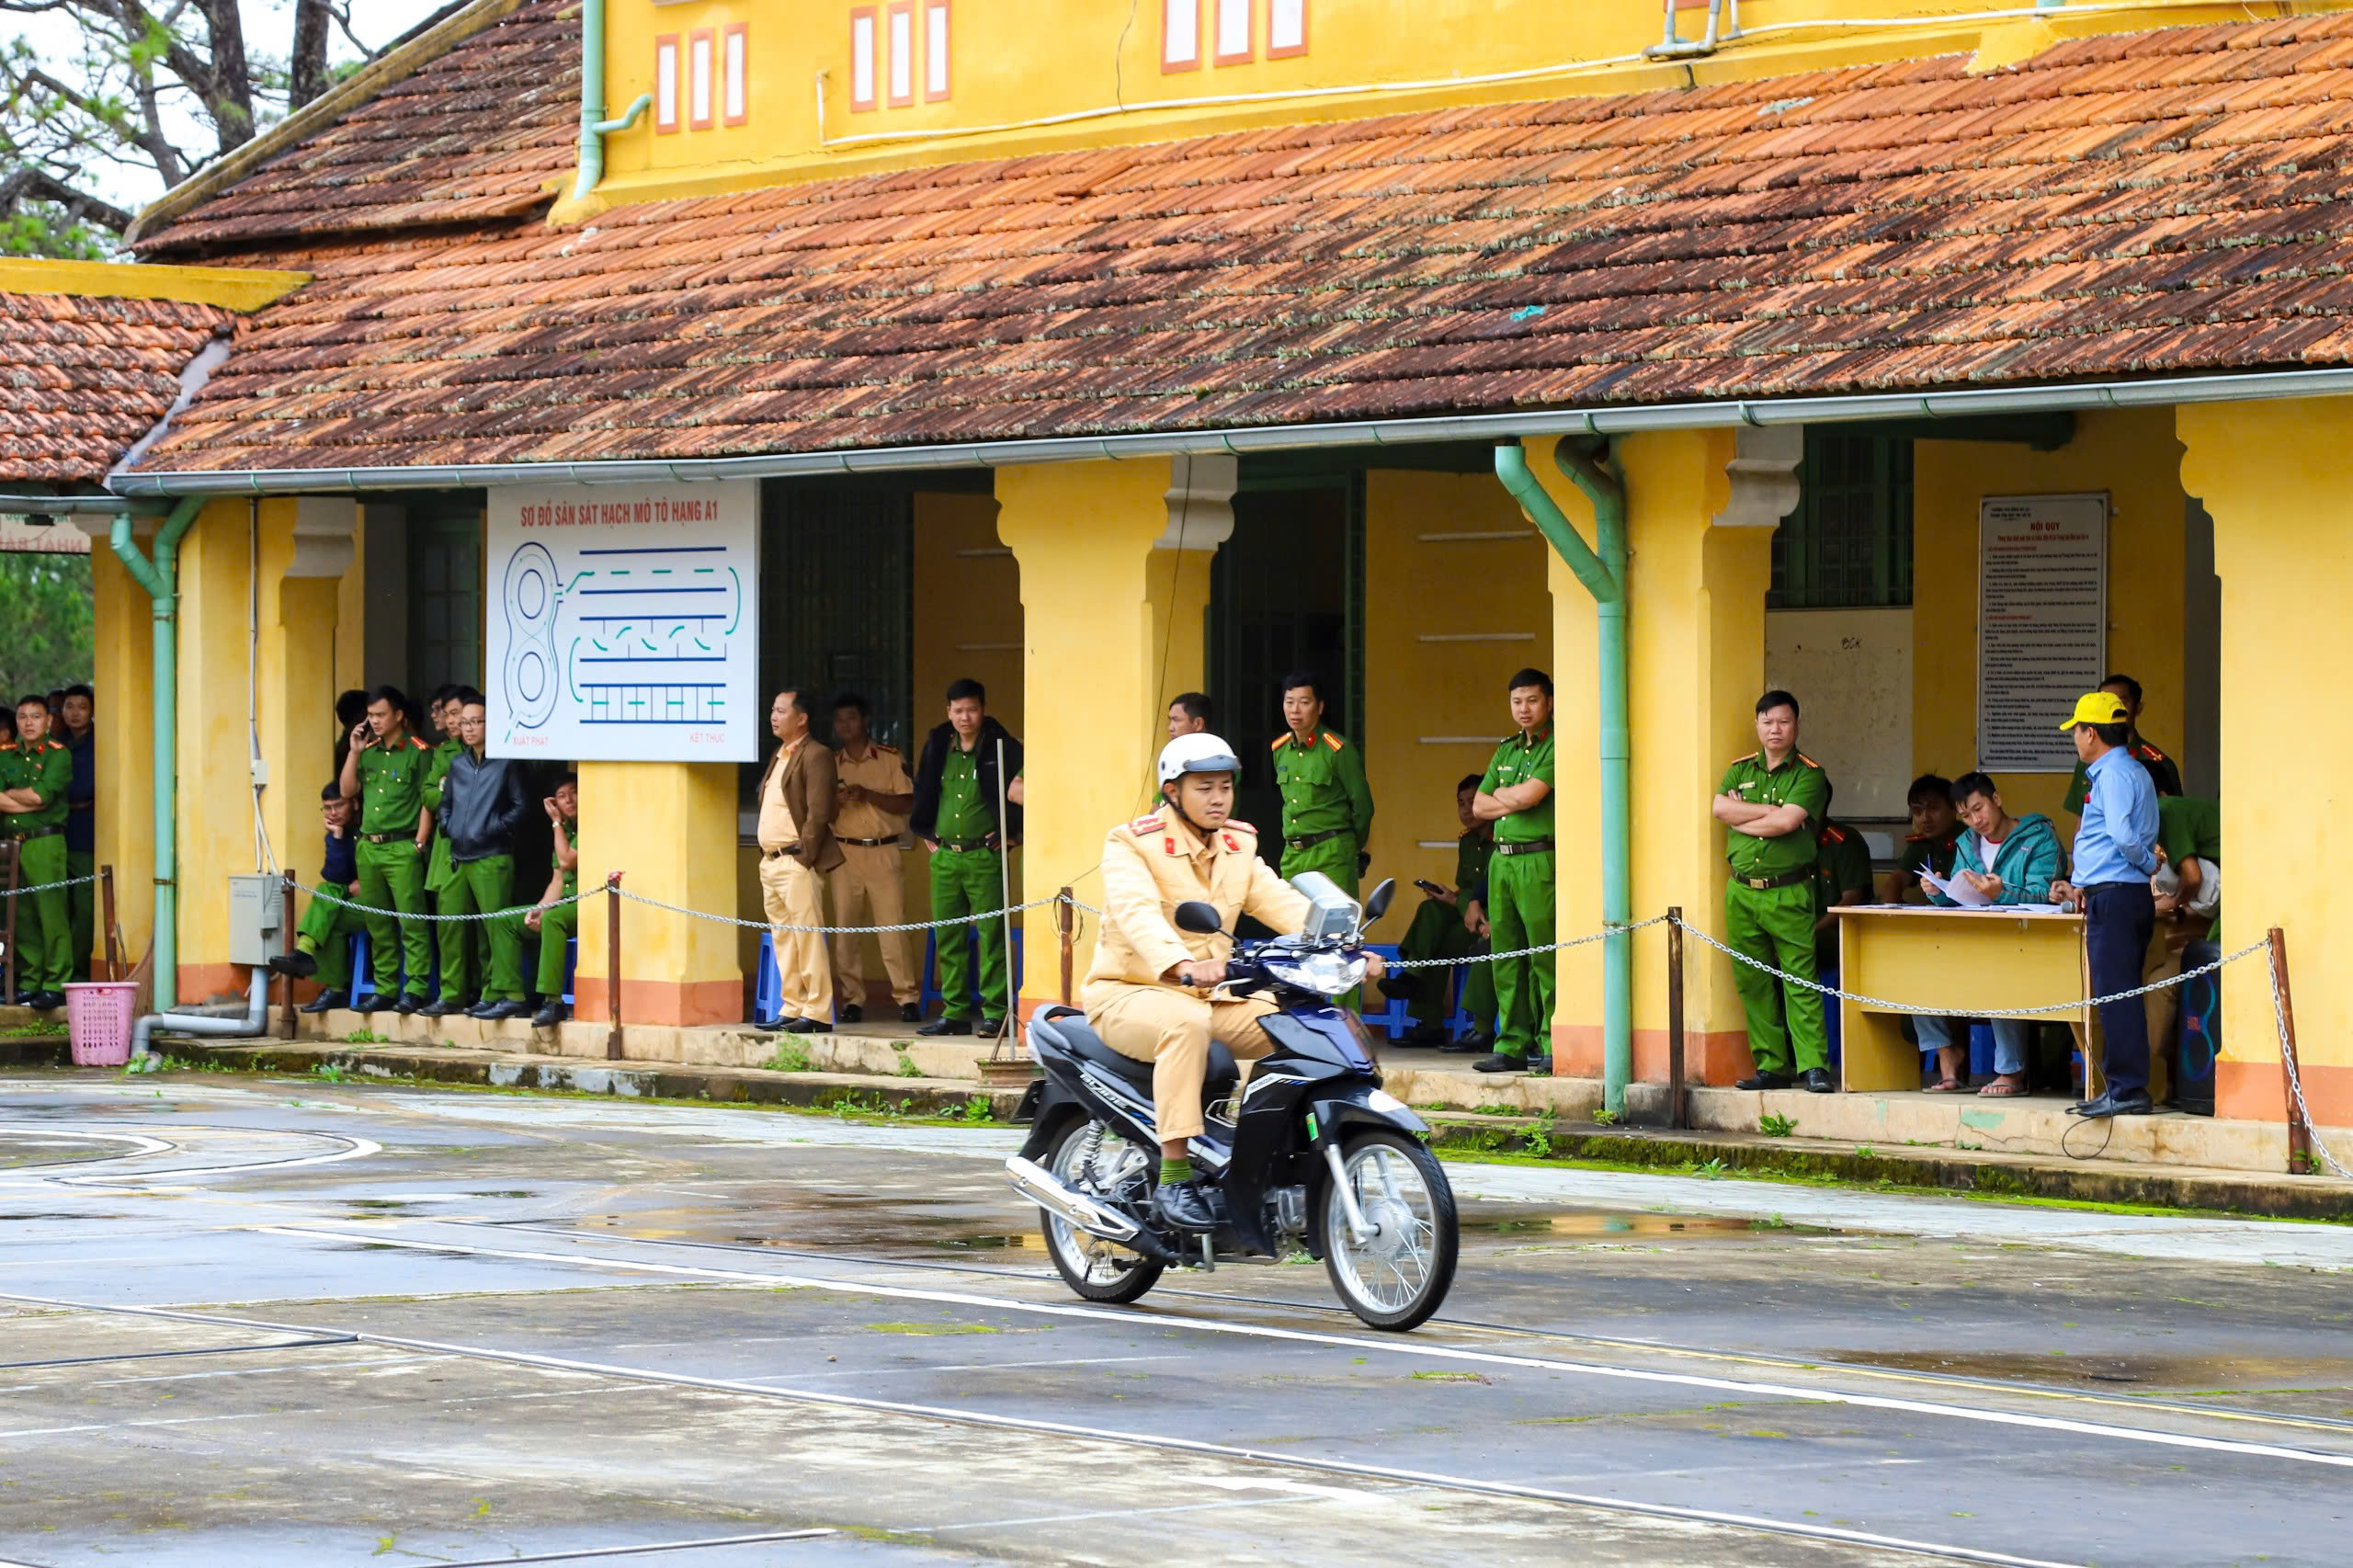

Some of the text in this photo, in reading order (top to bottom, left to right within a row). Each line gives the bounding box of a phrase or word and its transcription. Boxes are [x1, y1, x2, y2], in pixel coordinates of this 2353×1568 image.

[521, 505, 535, 527] SƠ
[538, 500, 551, 527] ĐỒ
[579, 500, 597, 525] SÁT
[602, 503, 631, 529] HẠCH
[633, 497, 651, 523] MÔ
[654, 496, 668, 523] TÔ
[672, 501, 701, 527] HẠNG
[705, 500, 718, 521] A1
